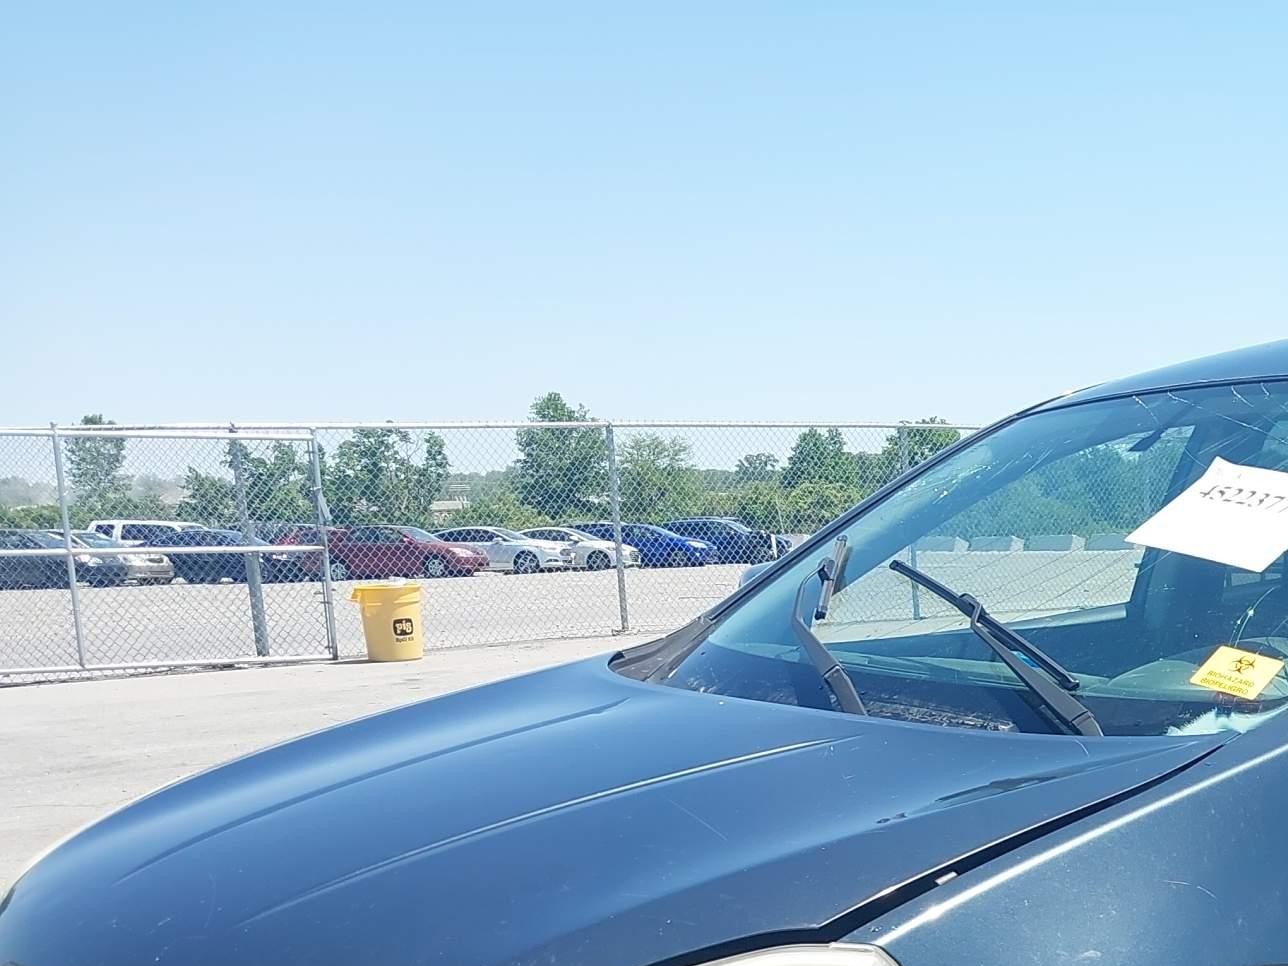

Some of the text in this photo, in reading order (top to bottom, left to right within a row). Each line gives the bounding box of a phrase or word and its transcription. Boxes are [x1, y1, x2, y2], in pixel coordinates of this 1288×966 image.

[395, 620, 412, 633] pig
[1200, 678, 1248, 694] BIOPELIGRO
[1207, 670, 1255, 688] BIOHAZARD
